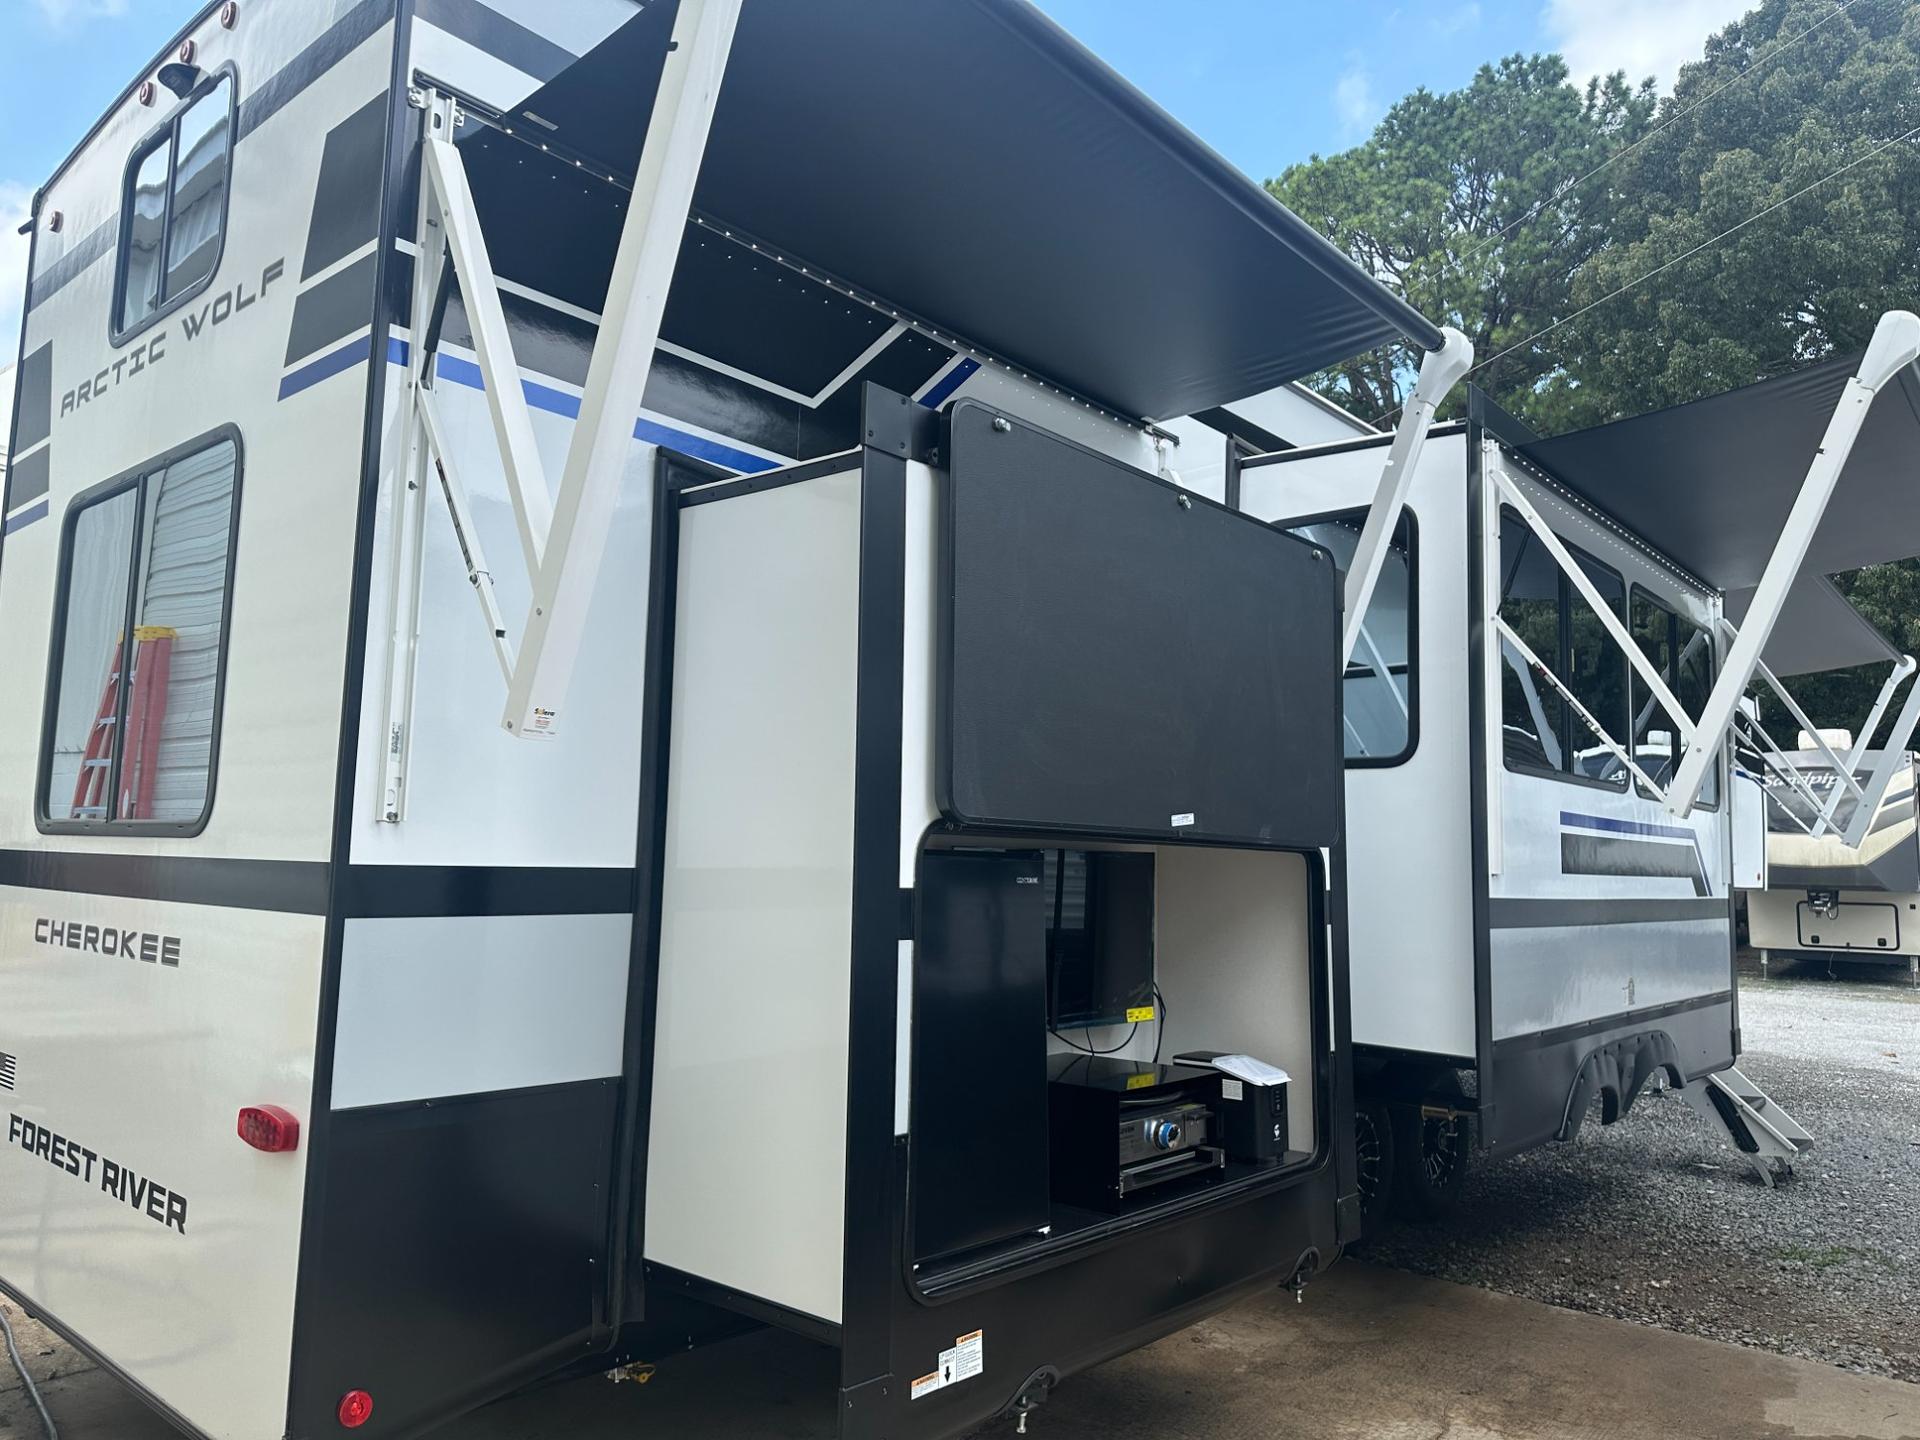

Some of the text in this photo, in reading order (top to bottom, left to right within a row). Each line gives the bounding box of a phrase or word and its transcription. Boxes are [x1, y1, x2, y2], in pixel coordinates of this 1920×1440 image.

[60, 256, 285, 418] ARCTIC WOLF
[1763, 771, 1863, 789] Sandpip
[35, 918, 182, 968] CHEROKEE
[9, 1113, 189, 1236] FOREST RIVER
